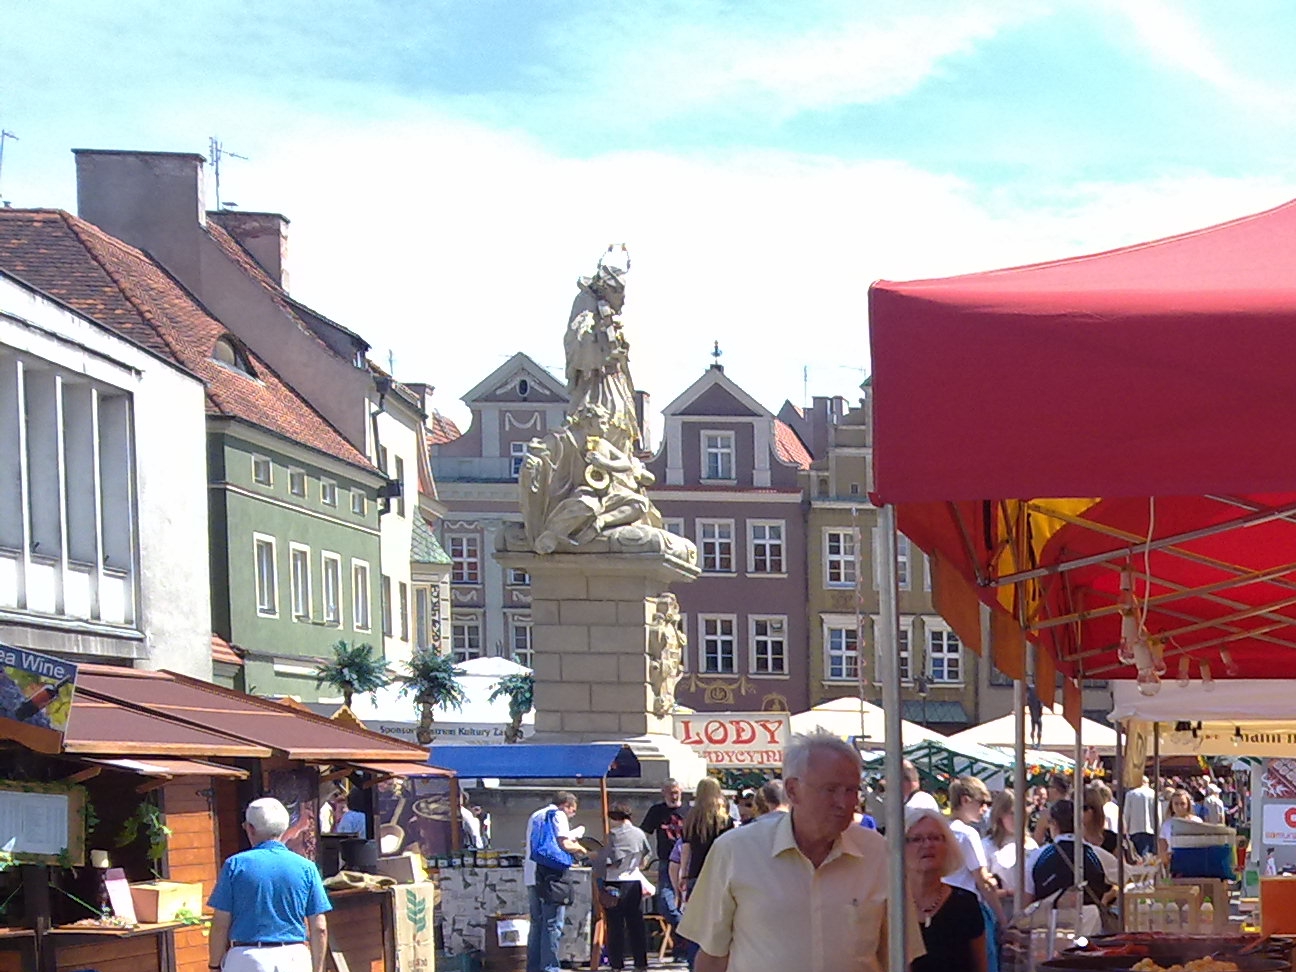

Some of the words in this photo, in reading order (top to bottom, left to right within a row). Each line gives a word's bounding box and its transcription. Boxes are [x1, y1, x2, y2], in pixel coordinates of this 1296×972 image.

[21, 652, 65, 679] Wine
[680, 719, 784, 745] LODY
[701, 750, 784, 764] ADYCYJN
